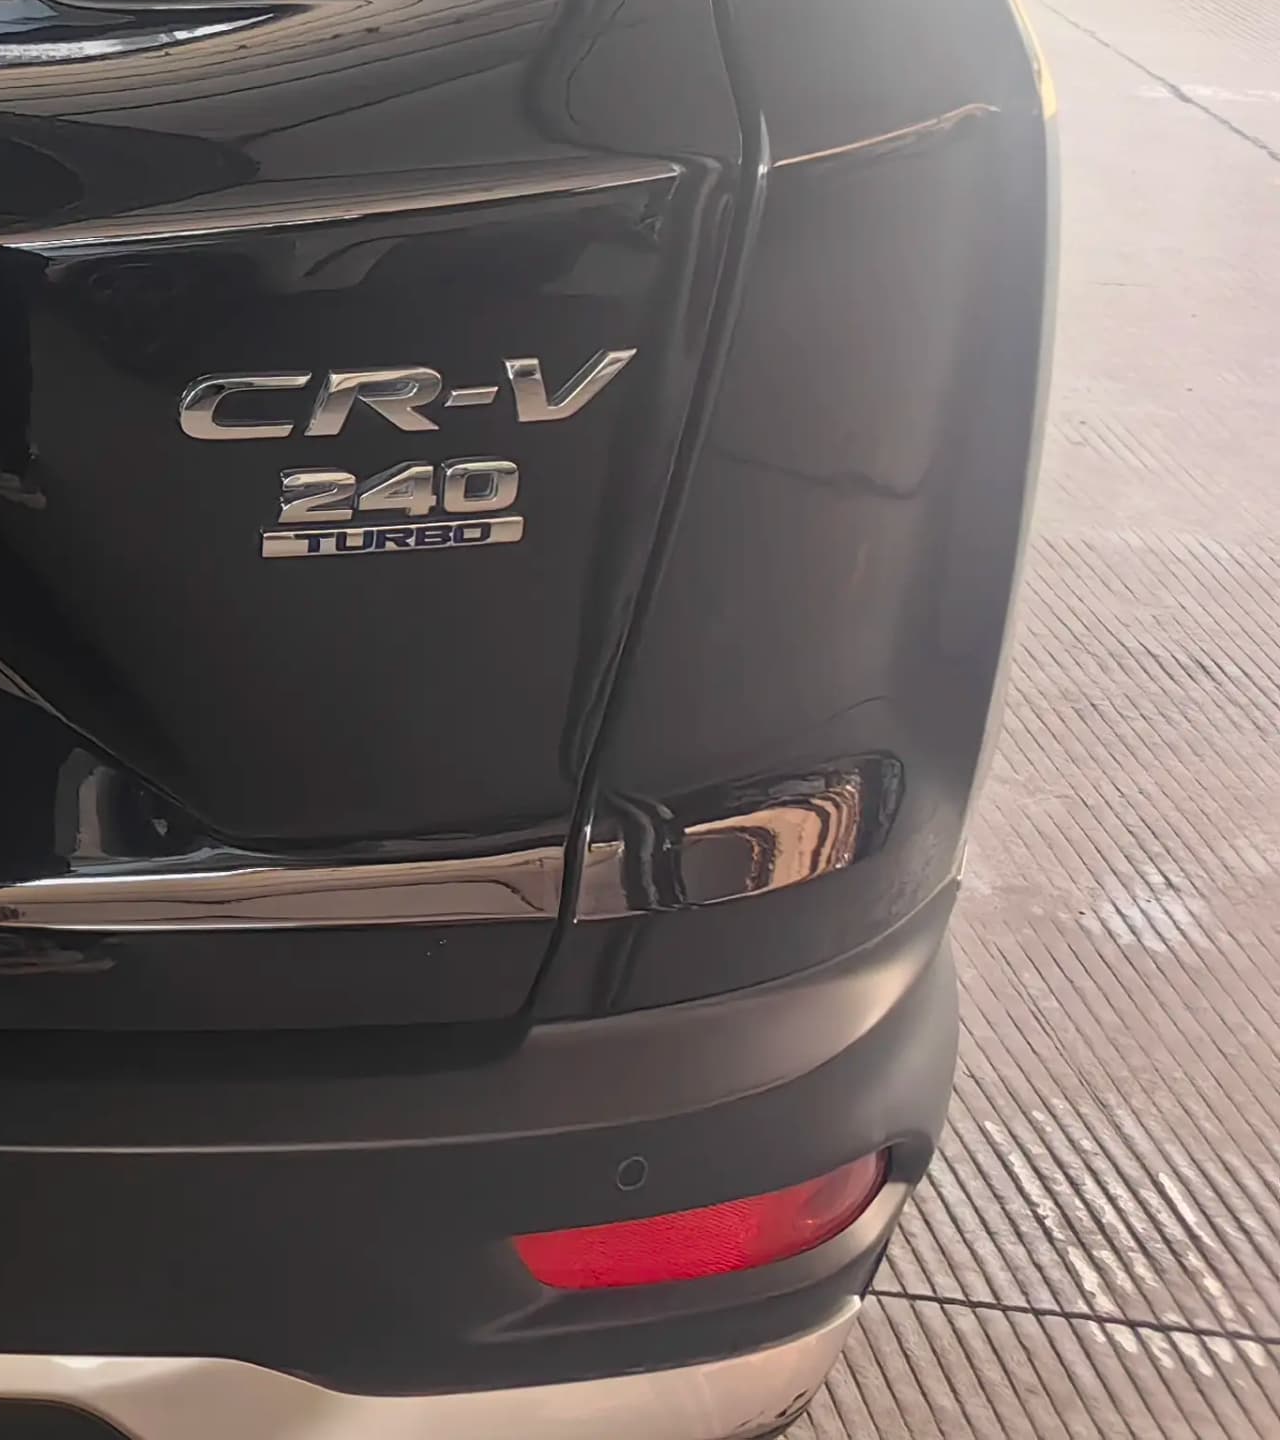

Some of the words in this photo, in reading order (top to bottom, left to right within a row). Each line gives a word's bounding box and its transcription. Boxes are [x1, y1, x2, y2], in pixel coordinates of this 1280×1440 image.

[178, 347, 638, 441] CR-V
[277, 456, 520, 523] 240
[293, 520, 492, 554] TURBO
